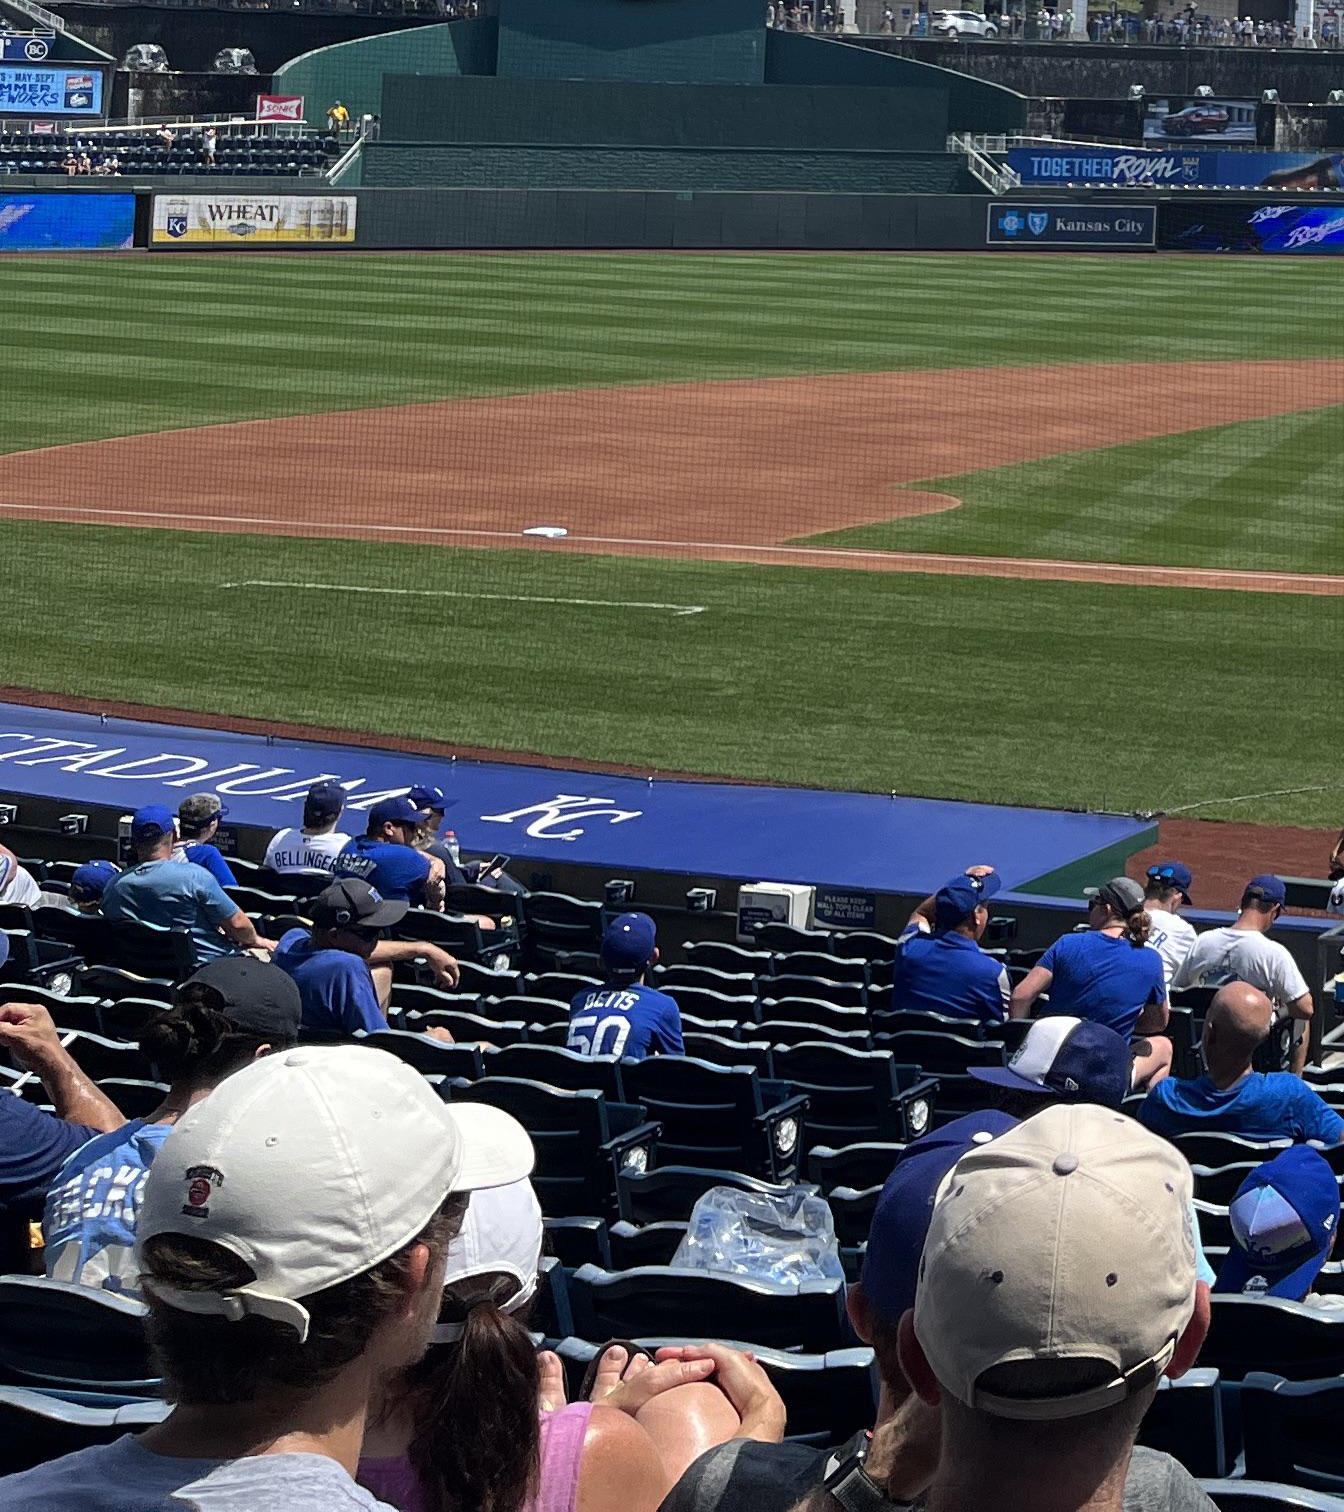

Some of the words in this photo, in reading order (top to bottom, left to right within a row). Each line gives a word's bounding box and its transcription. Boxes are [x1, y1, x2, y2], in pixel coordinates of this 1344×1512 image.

[265, 102, 295, 114] SONIC
[1030, 156, 1113, 177] TOGETHER
[1112, 154, 1182, 179] ROYAL
[208, 204, 279, 222] WHEAT
[1055, 217, 1110, 232] Kansas
[1115, 217, 1145, 236] City
[480, 795, 643, 841] KC
[584, 990, 640, 1010] BETTS
[567, 1015, 631, 1063] 50
